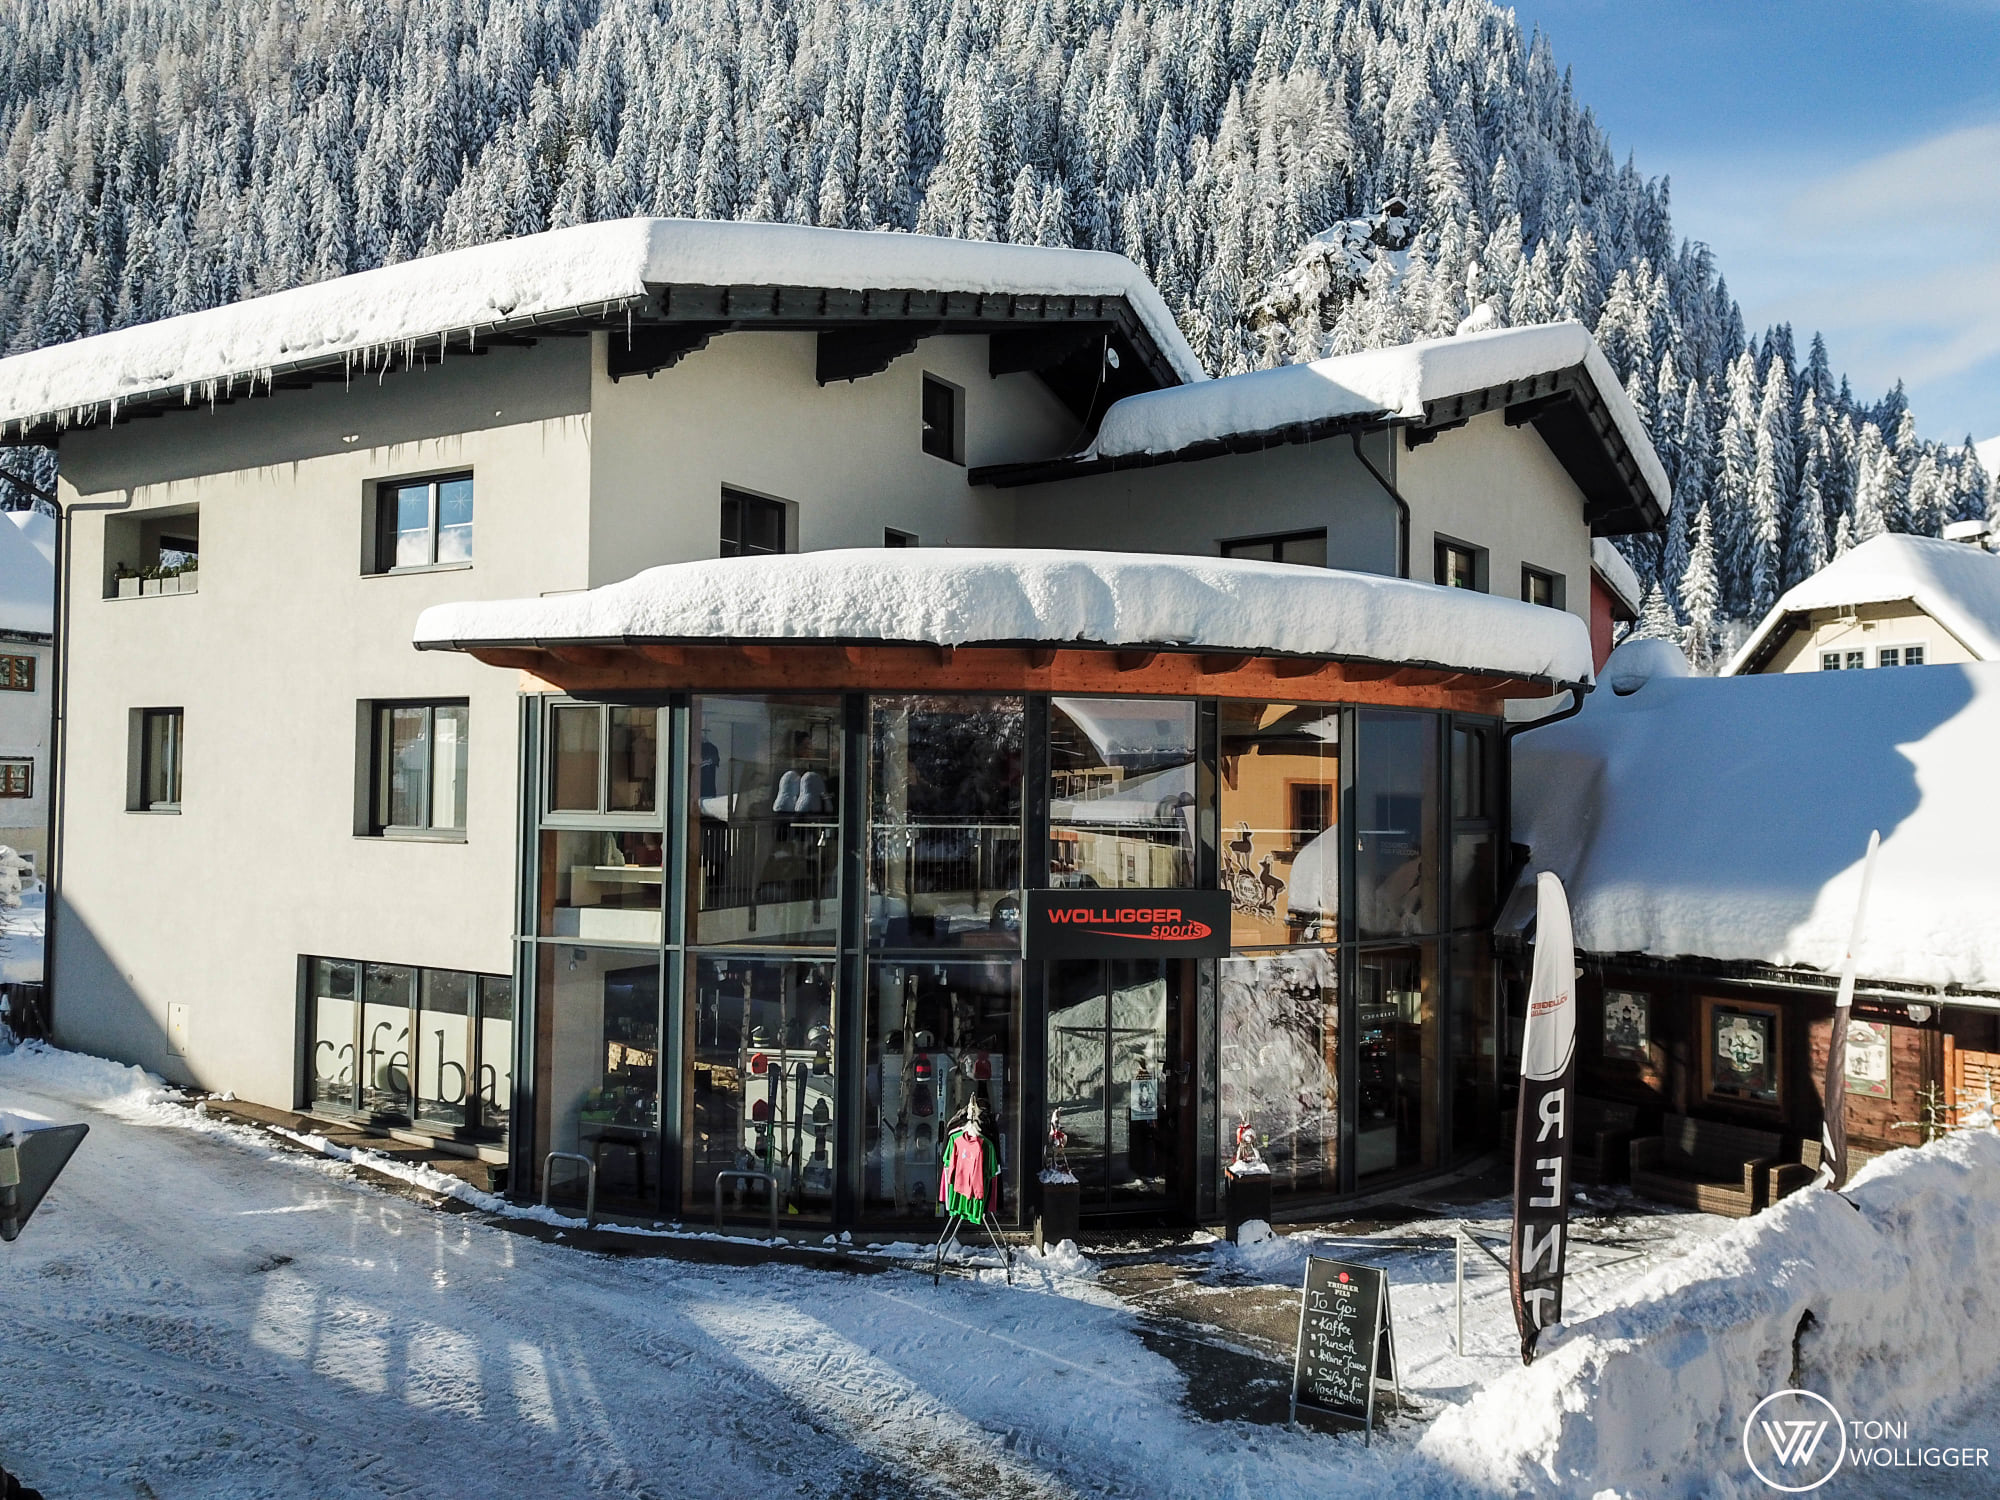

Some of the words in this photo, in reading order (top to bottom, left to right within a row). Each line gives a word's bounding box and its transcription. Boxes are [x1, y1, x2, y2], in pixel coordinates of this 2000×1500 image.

[1048, 908, 1182, 924] WOLLIGGER
[1151, 923, 1203, 940] sports
[315, 1021, 410, 1094] café
[1327, 1281, 1359, 1292] TRUMER
[1334, 1289, 1351, 1297] PILS
[1311, 1291, 1328, 1309] To
[1319, 1316, 1352, 1337] Kaffee
[1317, 1333, 1357, 1354] Punsch
